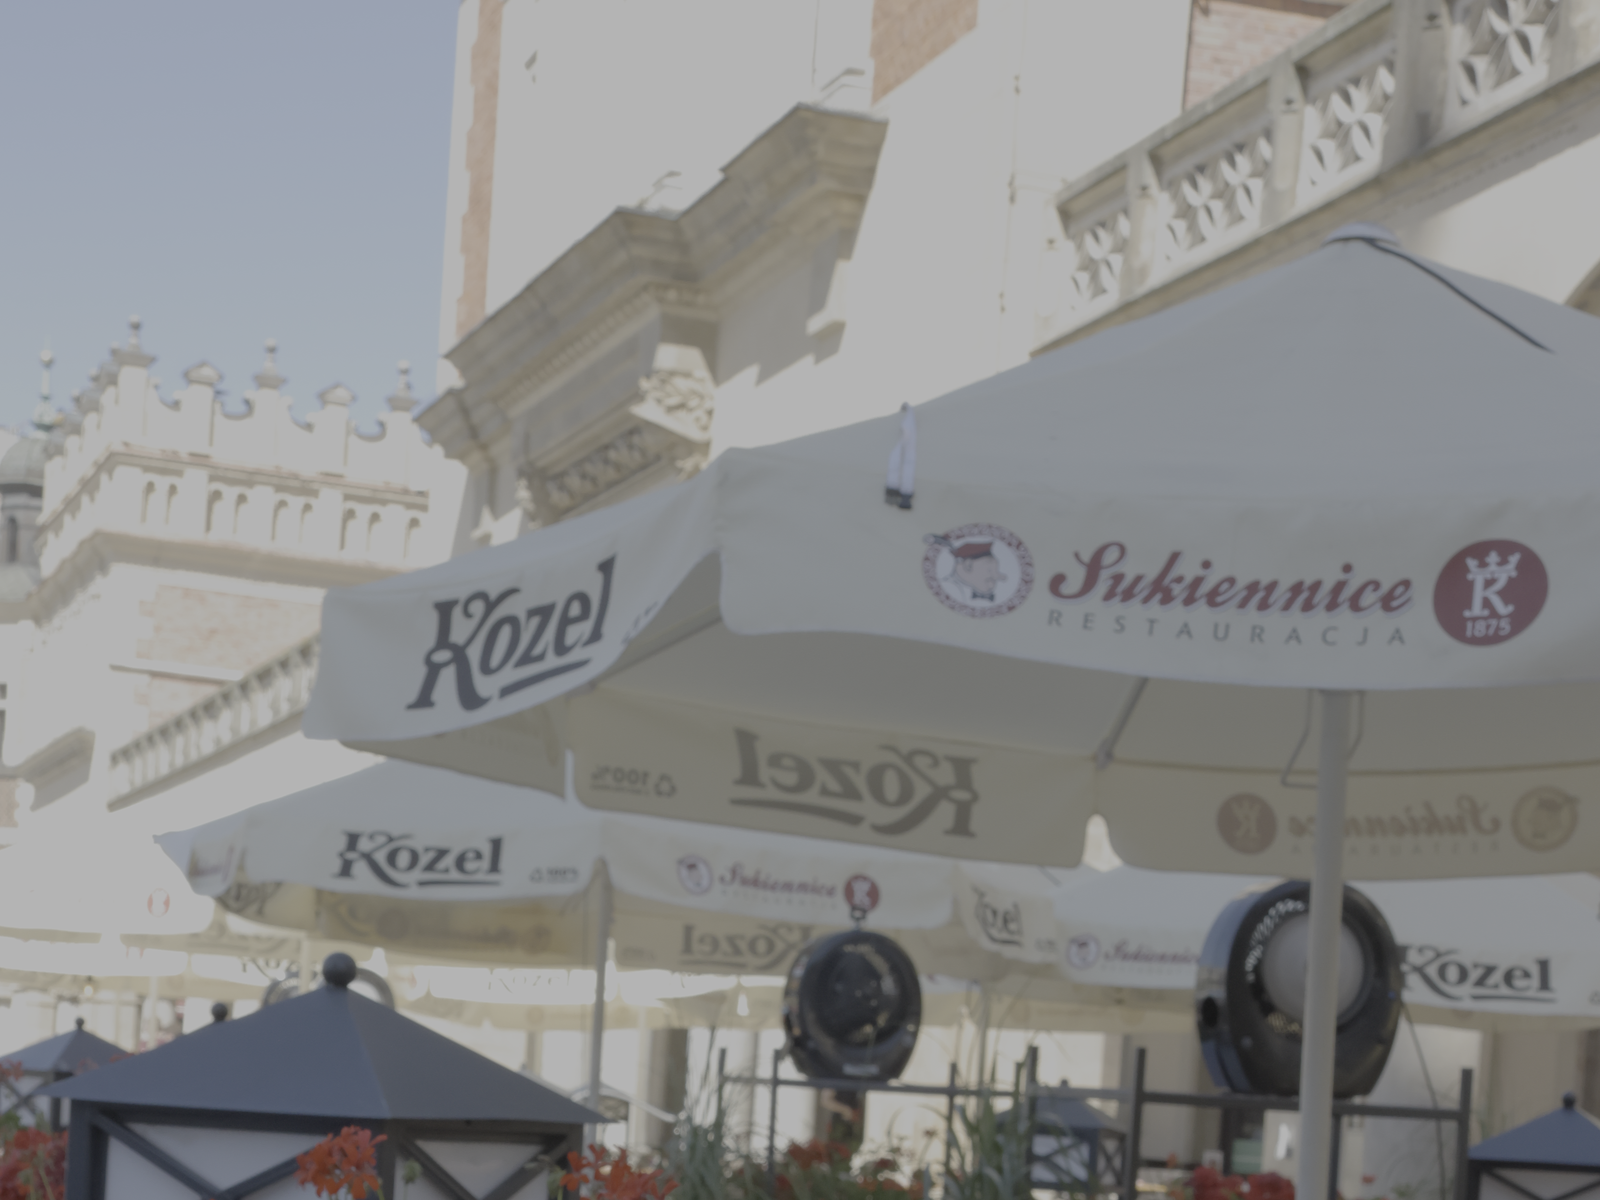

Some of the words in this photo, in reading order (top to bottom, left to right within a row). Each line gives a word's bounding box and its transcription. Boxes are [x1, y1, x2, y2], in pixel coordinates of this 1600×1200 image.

[1048, 540, 1414, 616] Sukiennice
[404, 552, 618, 712] Kozel
[1047, 609, 1407, 647] RESTAURACJA
[1464, 618, 1512, 639] 1875
[332, 830, 504, 889] Kozel
[1400, 943, 1558, 1003] Kozel
